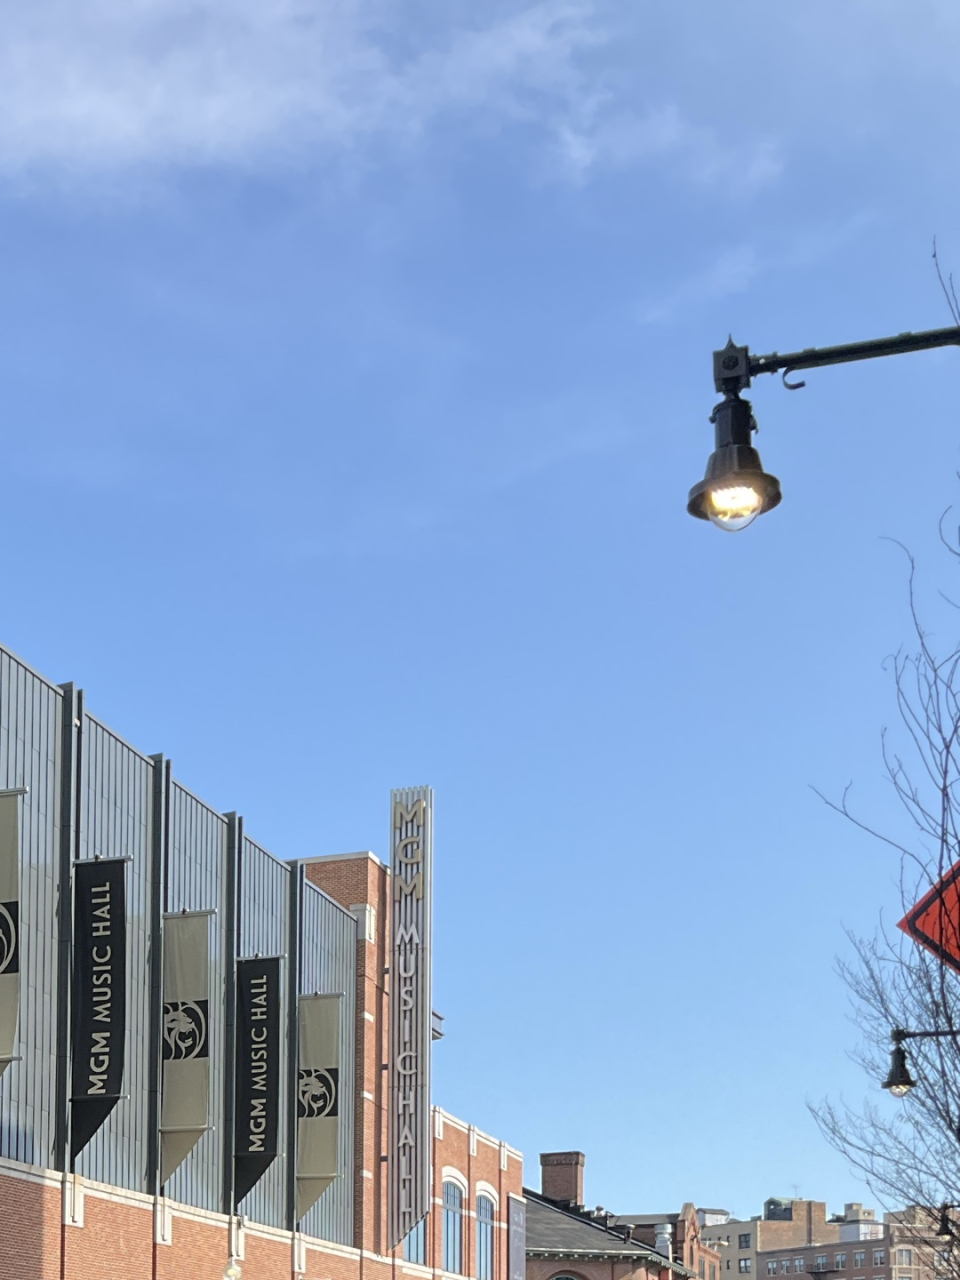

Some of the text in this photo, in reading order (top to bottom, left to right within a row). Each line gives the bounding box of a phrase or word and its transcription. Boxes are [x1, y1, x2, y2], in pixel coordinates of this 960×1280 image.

[87, 881, 112, 1095] MGM MUSIC HALL
[248, 974, 268, 1152] MGM MUSIC HALL
[394, 799, 426, 1214] MGM MUSIC HALL
